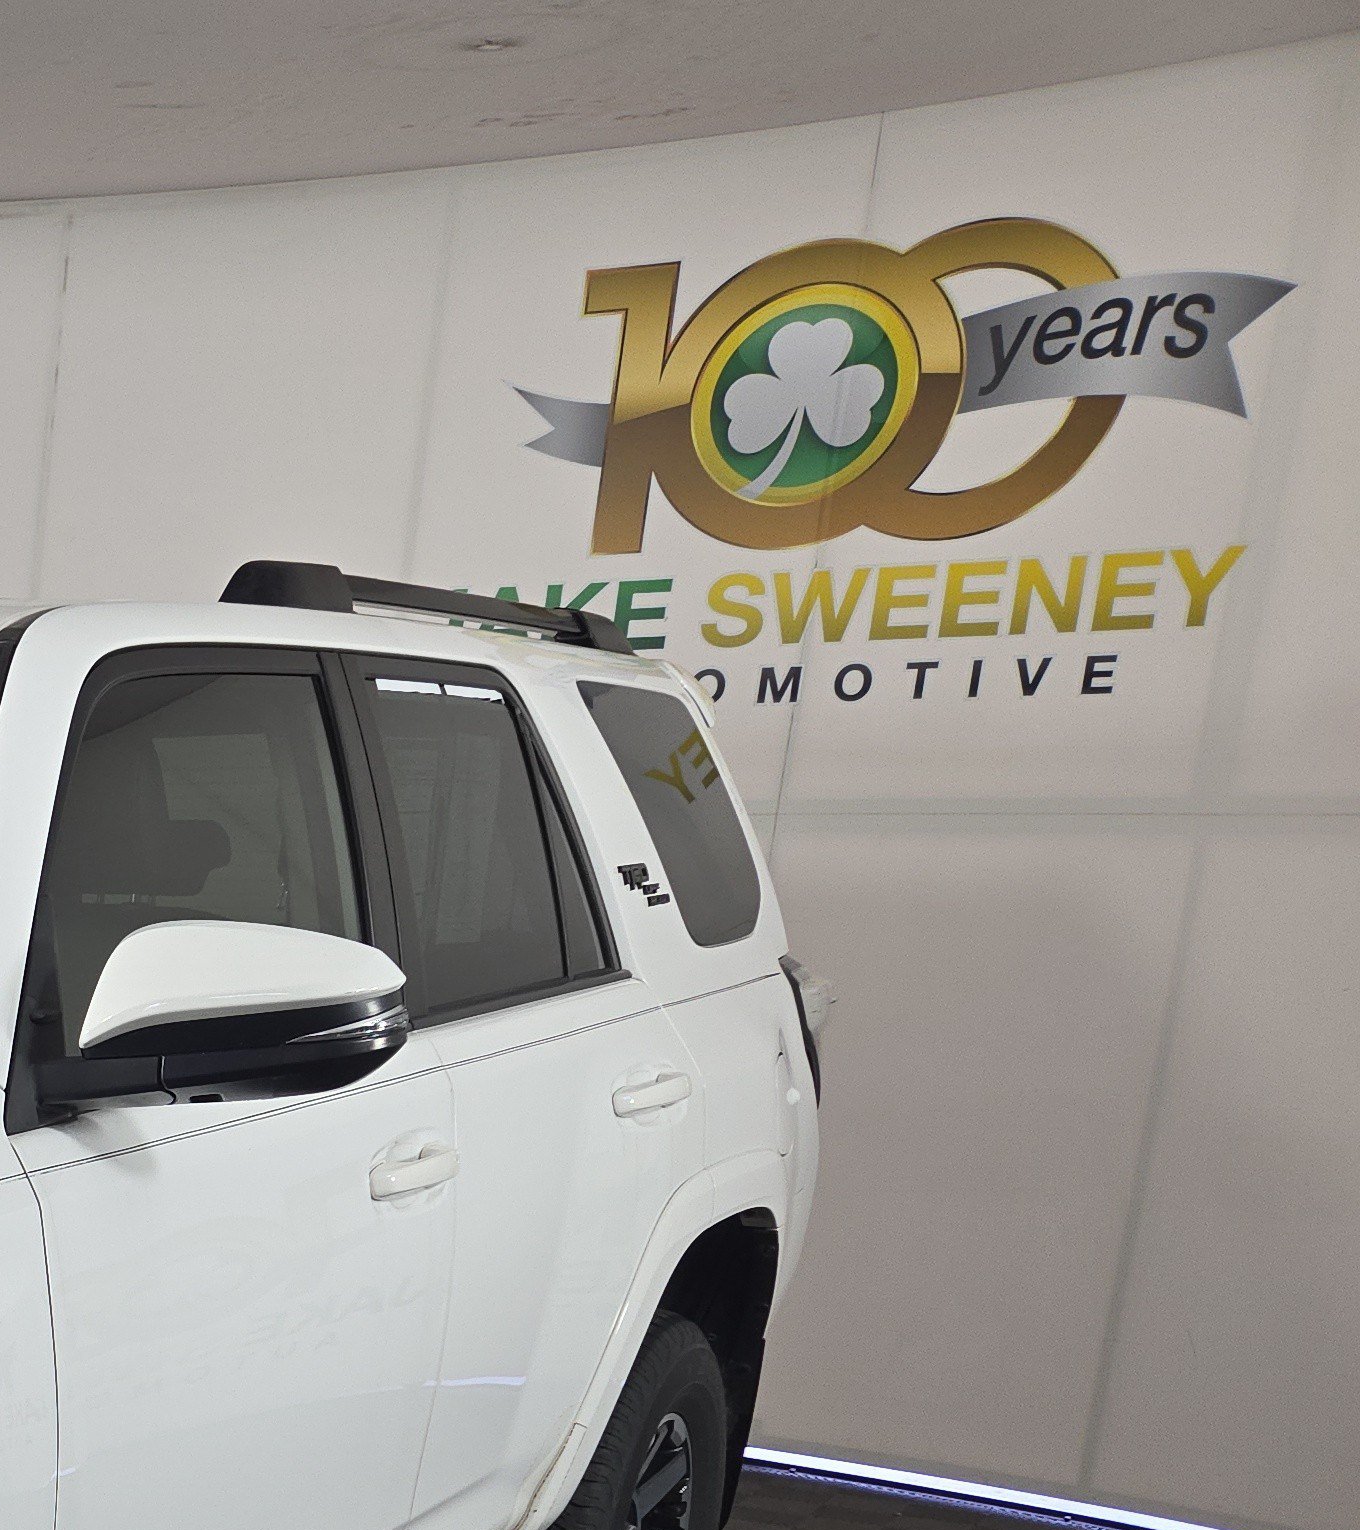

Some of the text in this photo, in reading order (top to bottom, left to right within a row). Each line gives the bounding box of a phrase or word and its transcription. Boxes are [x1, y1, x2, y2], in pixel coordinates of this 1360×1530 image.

[581, 216, 1216, 556] 100 years
[699, 544, 1248, 648] SWEENEY
